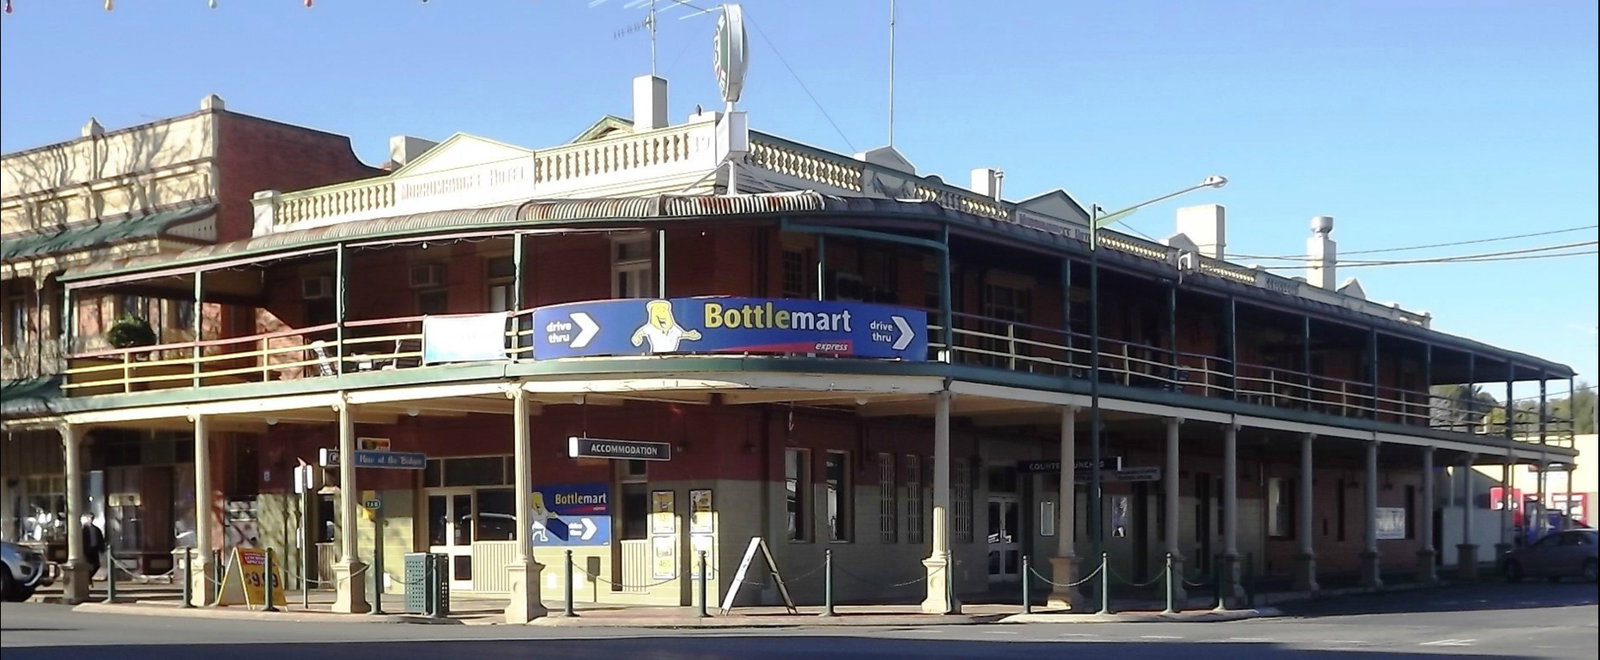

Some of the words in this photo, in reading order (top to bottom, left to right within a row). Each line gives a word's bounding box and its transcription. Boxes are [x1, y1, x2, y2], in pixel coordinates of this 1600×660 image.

[704, 302, 852, 332] Bottlemart
[546, 321, 572, 332] drive
[870, 320, 893, 331] drive
[548, 333, 570, 344] thru
[872, 332, 892, 342] thru
[815, 342, 849, 351] express
[590, 443, 658, 455] ACCOMMODATION
[1029, 462, 1061, 470] COUNTE
[555, 492, 607, 504] Bottlemart
